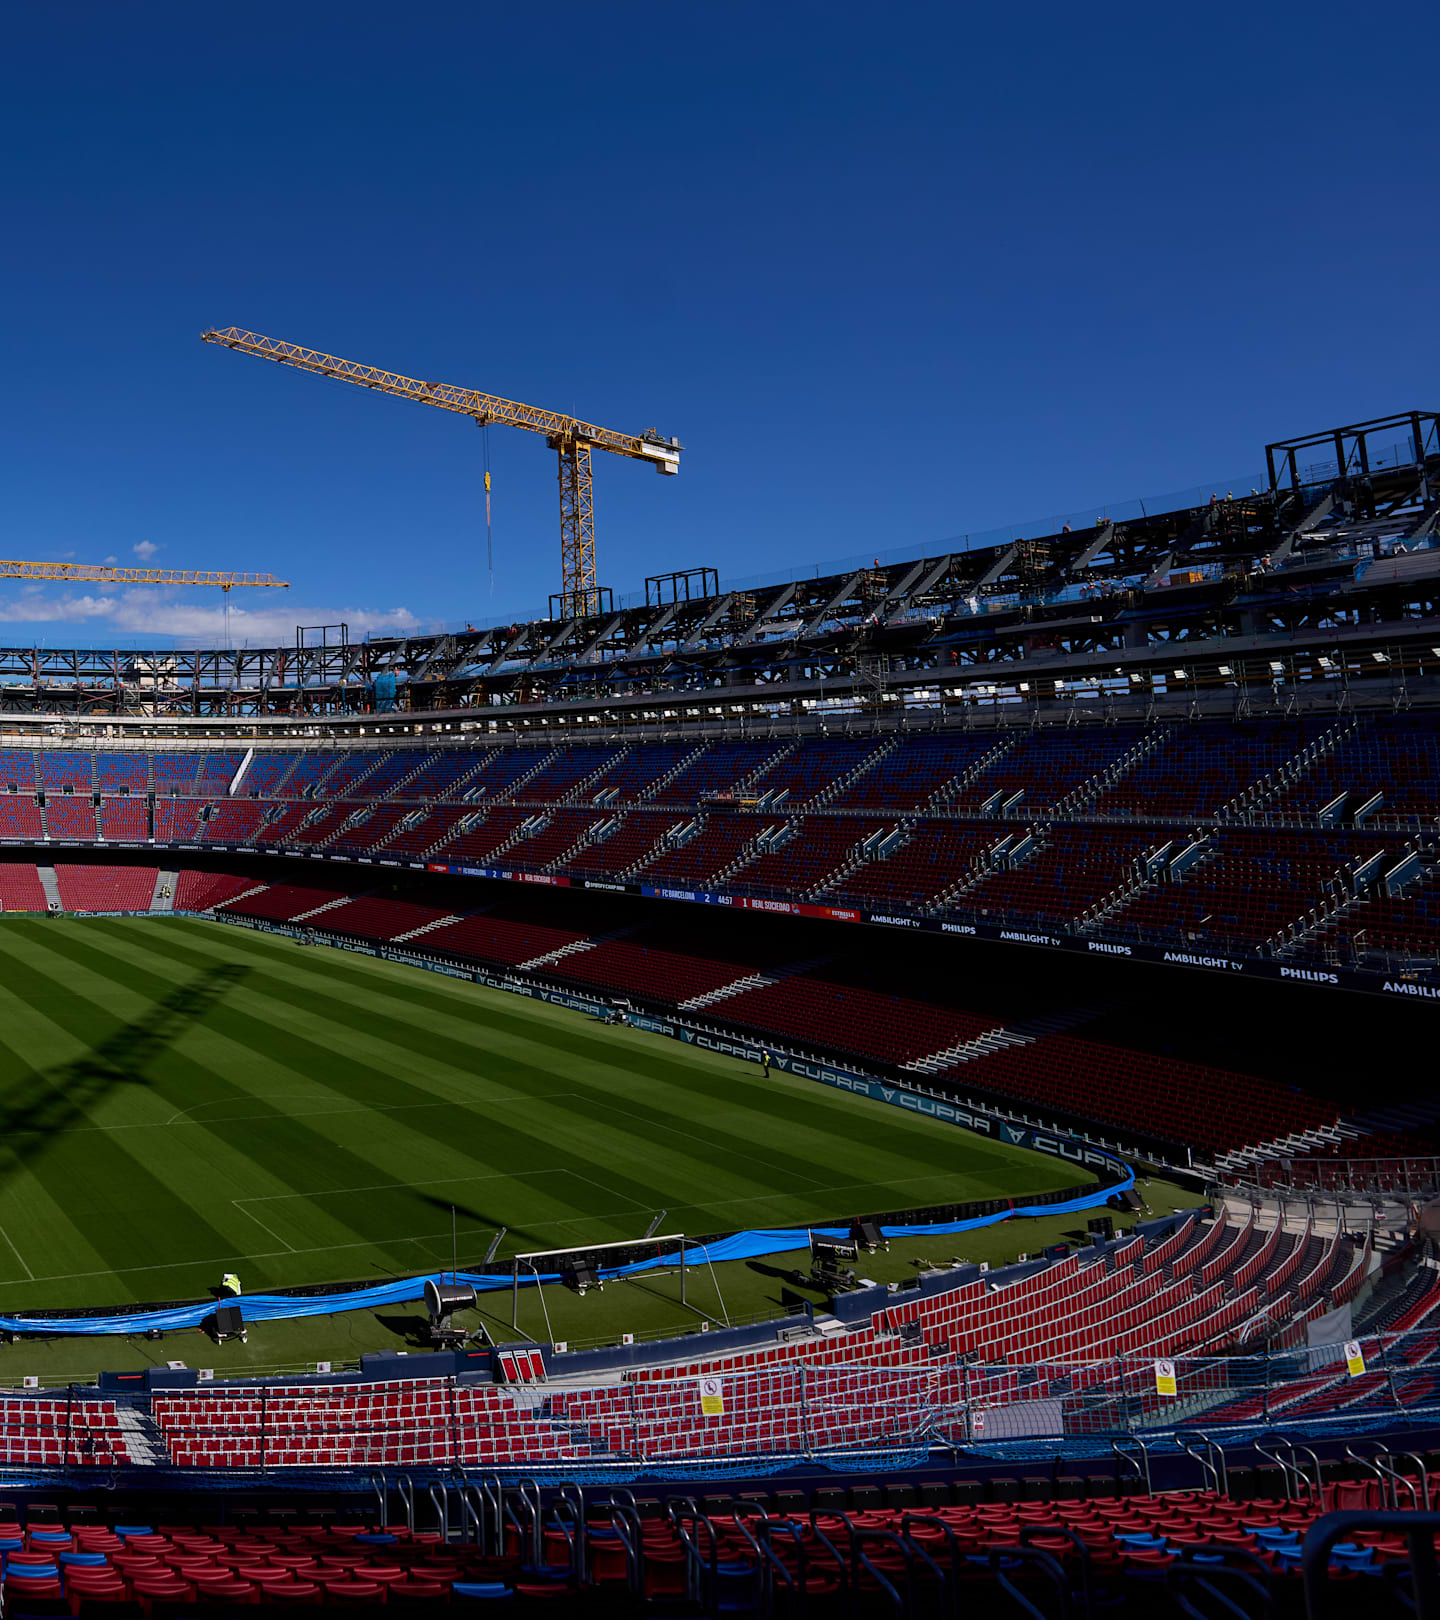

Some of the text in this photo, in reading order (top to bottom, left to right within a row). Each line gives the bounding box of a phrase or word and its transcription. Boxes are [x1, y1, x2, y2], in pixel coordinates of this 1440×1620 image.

[519, 873, 523, 881] 1
[662, 889, 790, 912] FC BARCELONA 2 44:57 1 REAL SOCIEDAD
[188, 912, 217, 921] CUPRA
[870, 915, 920, 928] AMBILIGHT tv
[227, 920, 255, 929] CUPRA
[264, 924, 292, 936] CUPRA
[941, 923, 976, 935] PHILIPS
[1000, 931, 1061, 946] AMBILIGHT tv
[344, 943, 376, 956] CUPRA
[1088, 942, 1132, 956] PHILIPS
[388, 955, 423, 969] CUPRA
[1163, 952, 1243, 970] AMBILIGHT tv
[434, 964, 472, 981] CUPRA
[1280, 967, 1339, 984] PHILIPS
[486, 978, 532, 997] CUPRA
[551, 995, 600, 1015] CUPRA
[697, 1036, 762, 1063] CUPRA
[792, 1062, 870, 1095] CUPRA
[900, 1095, 990, 1133] CUPRA
